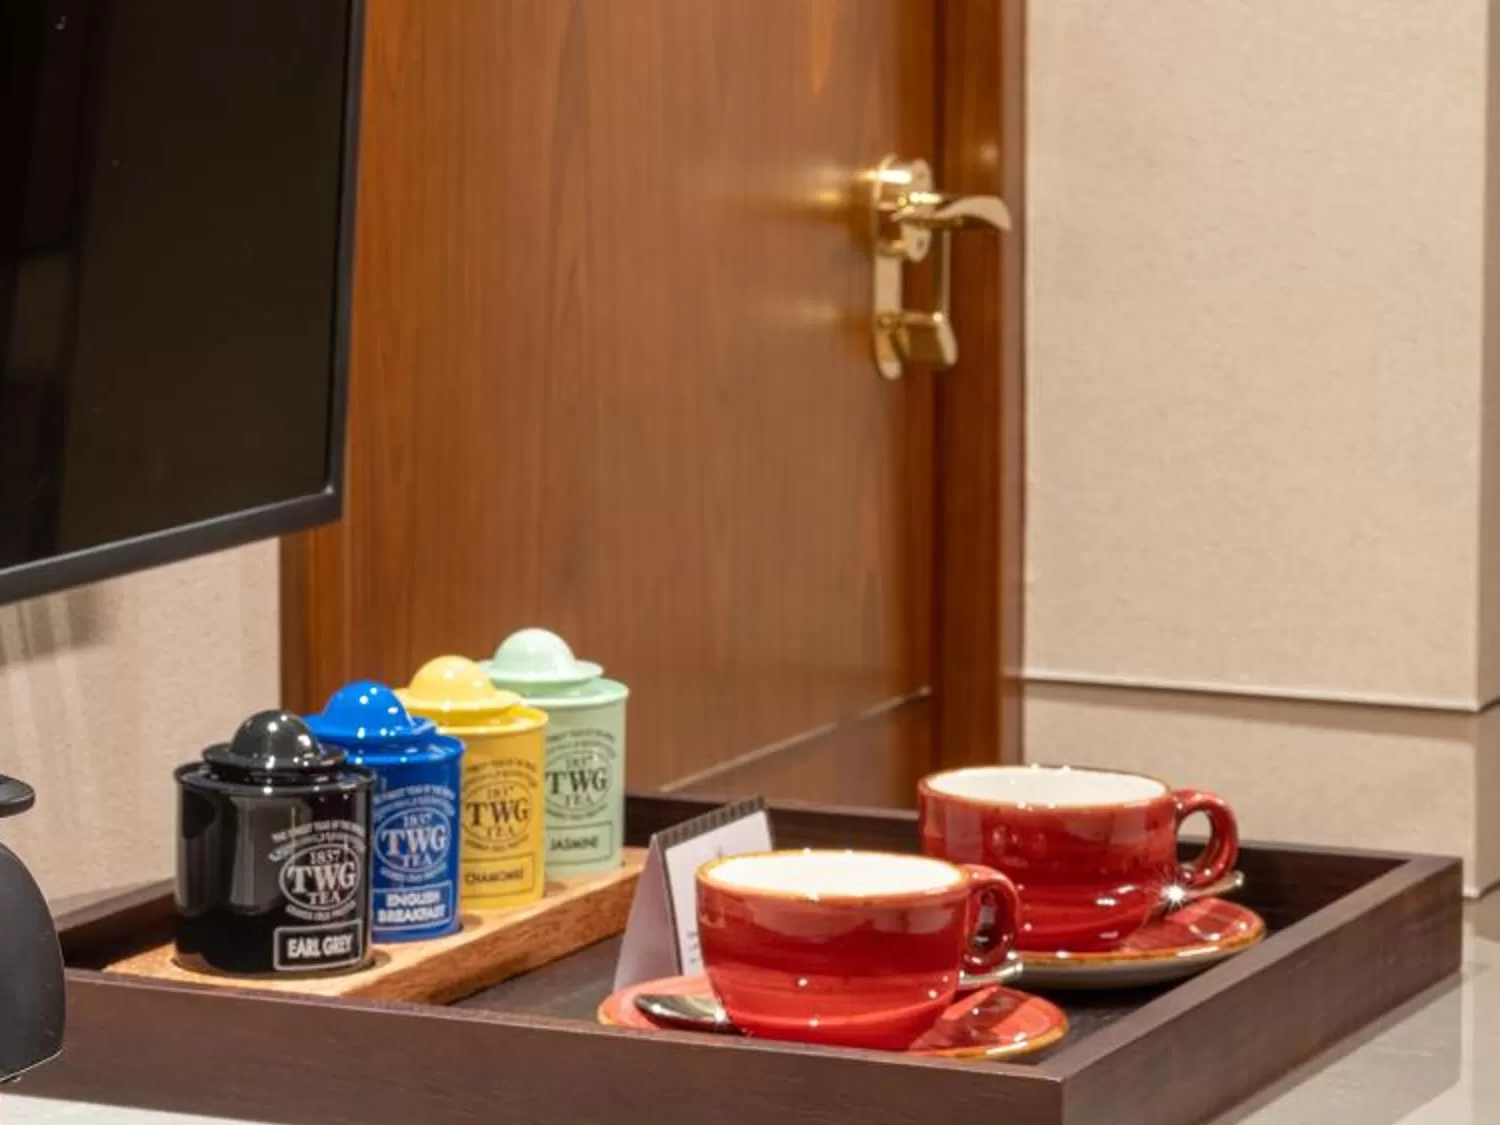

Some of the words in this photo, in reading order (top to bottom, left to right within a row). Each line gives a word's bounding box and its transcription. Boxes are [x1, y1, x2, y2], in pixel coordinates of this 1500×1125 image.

[545, 767, 607, 794] TWG
[466, 797, 529, 826] TWG
[381, 824, 447, 856] TWG
[309, 850, 340, 865] 1837
[287, 862, 356, 893] TWG
[308, 891, 341, 905] TEA
[386, 890, 441, 907] ENGLISH
[377, 904, 446, 924] BREAKFAST
[287, 938, 321, 958] EARL
[322, 934, 355, 957] GREY
